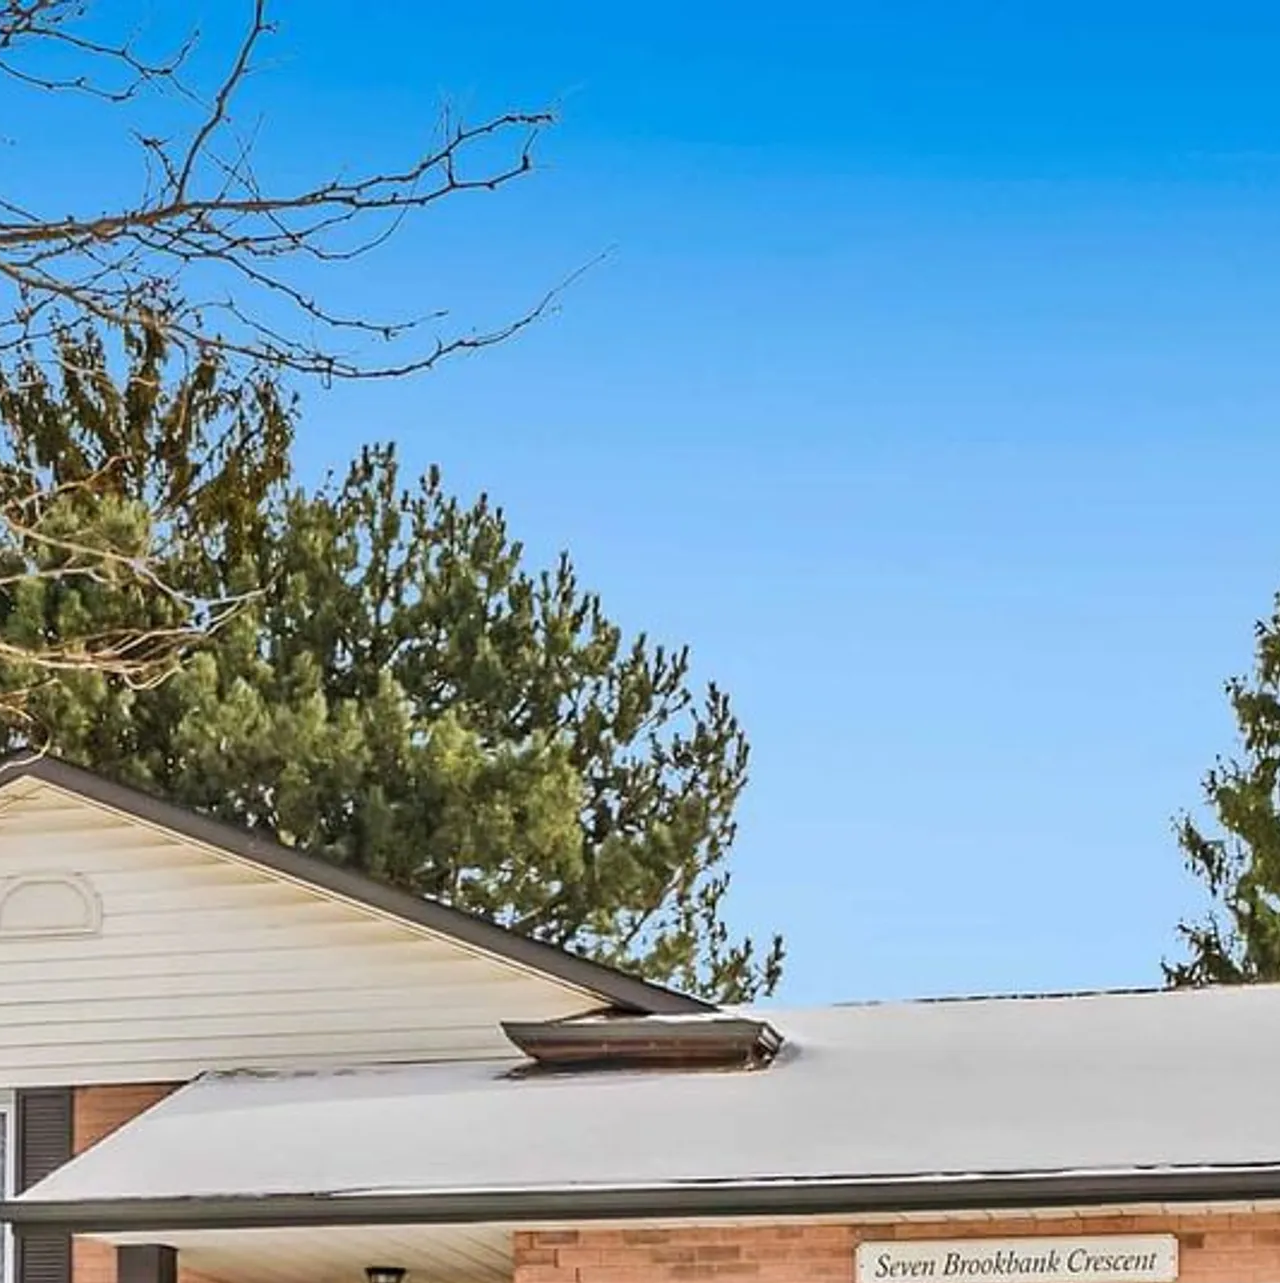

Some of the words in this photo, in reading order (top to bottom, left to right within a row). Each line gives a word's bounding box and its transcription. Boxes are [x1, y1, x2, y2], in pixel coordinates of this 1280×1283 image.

[875, 1252, 936, 1278] Seven
[942, 1249, 1060, 1276] Brookbank
[1066, 1247, 1158, 1272] Crescent
